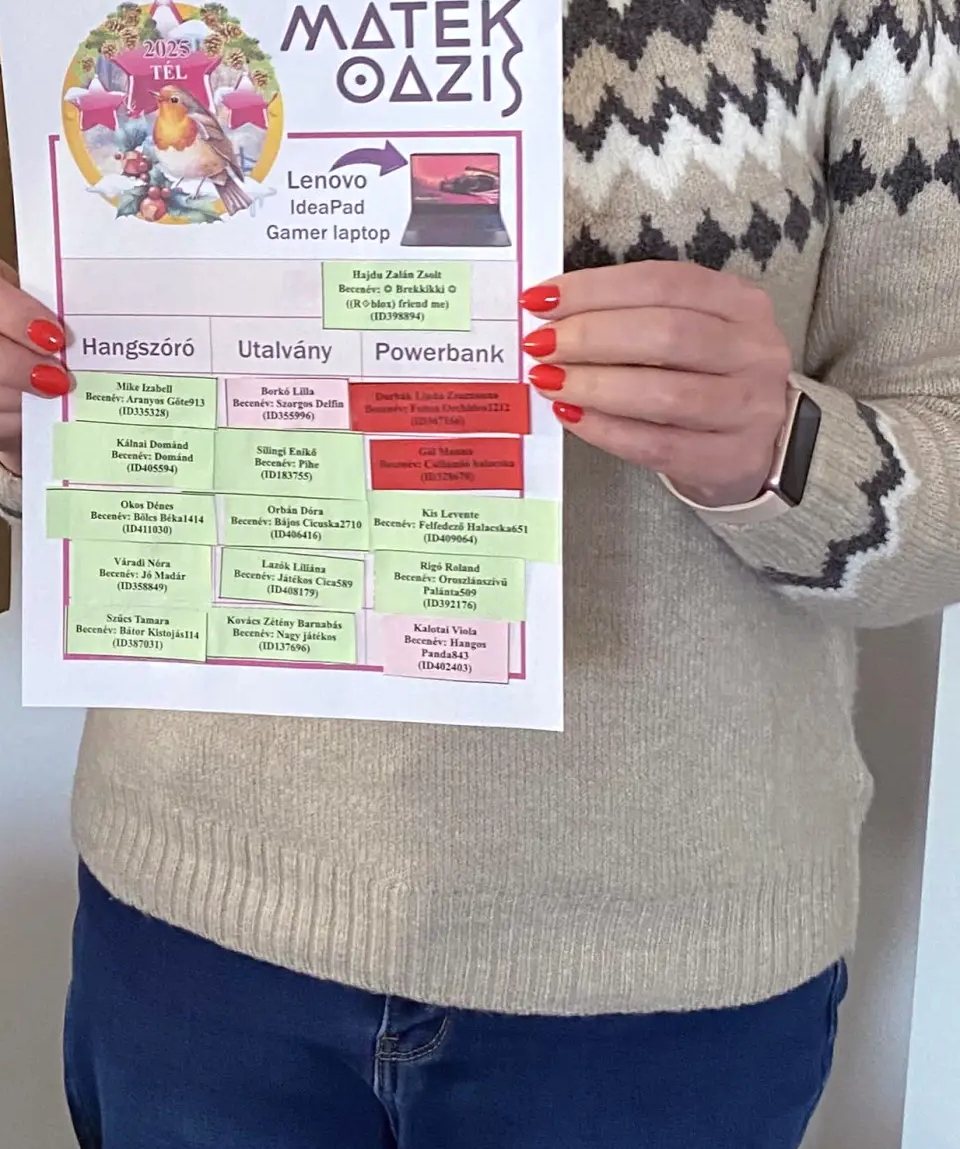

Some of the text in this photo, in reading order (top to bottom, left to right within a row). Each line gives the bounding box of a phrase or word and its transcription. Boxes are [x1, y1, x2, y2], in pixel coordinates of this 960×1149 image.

[281, 0, 523, 52] MATEK
[143, 39, 191, 58] 2025
[150, 63, 187, 80] TÉL
[337, 51, 523, 117] OAZIS
[287, 170, 367, 189] Lenovo
[290, 200, 365, 215] IdeaPad
[266, 224, 390, 245] Gamer laptop
[353, 270, 442, 281] Hajdu Zalán Zsolt
[338, 284, 380, 293] Becenév:
[399, 300, 428, 308] friend
[431, 300, 449, 308] me)
[370, 312, 424, 321] (ID398894)
[82, 337, 195, 359] Hangszóró
[238, 339, 332, 363] Utalvány
[375, 342, 505, 363] Powerbank
[116, 382, 172, 393] Mike Izabell
[261, 387, 290, 395] Borkó
[86, 392, 124, 402] Becenév:
[126, 396, 164, 406] Aranyos
[233, 399, 344, 409] Becenév: Szorgos Delfin
[119, 407, 169, 418] (ID335328)
[262, 412, 315, 420] (ID355996)
[116, 438, 188, 450] Kálnai Dománd
[112, 451, 194, 462] Becenév: Dománd
[255, 458, 319, 468] Becenév: Pihe
[126, 464, 178, 474] (ID405594)
[261, 470, 312, 481] (ID183755)
[121, 501, 174, 510] Okos Dénes
[268, 505, 324, 515] Orbán Dóra
[91, 511, 130, 521] Becenév:
[160, 514, 204, 523] Béka1414
[422, 508, 479, 519] Kis Levente
[231, 516, 362, 528] Becenév: Bájos Cicuska2710
[374, 518, 416, 529] Becenév:
[467, 523, 528, 533] Halacska651
[122, 524, 172, 535] (ID411030)
[271, 530, 322, 541] (ID406416)
[424, 534, 478, 544] (ID409064)
[114, 557, 171, 568] Váradi Nóra
[420, 561, 480, 572] Rigó Roland
[99, 569, 186, 580] Becenév: Jó Madár
[234, 569, 353, 588] Becenév: Játékos Cica589
[394, 572, 436, 582] Becenév:
[117, 582, 167, 593] (ID358849)
[267, 584, 319, 598] (ID408179)
[423, 599, 477, 611] (ID392176)
[135, 615, 170, 625] Tamara
[227, 615, 260, 625] Kovács
[298, 619, 342, 629] Barnabás
[76, 625, 117, 634] Becenév:
[120, 627, 145, 635] Bátor
[233, 629, 337, 641] Becenév: Nagy játékos
[413, 624, 477, 636] Kalotai Viola
[113, 638, 163, 650] (ID387031)
[259, 641, 310, 653] (ID137696)
[404, 636, 487, 650] Becenév: Hangos
[421, 649, 469, 659] Panda843
[418, 661, 472, 673] (ID402403)
